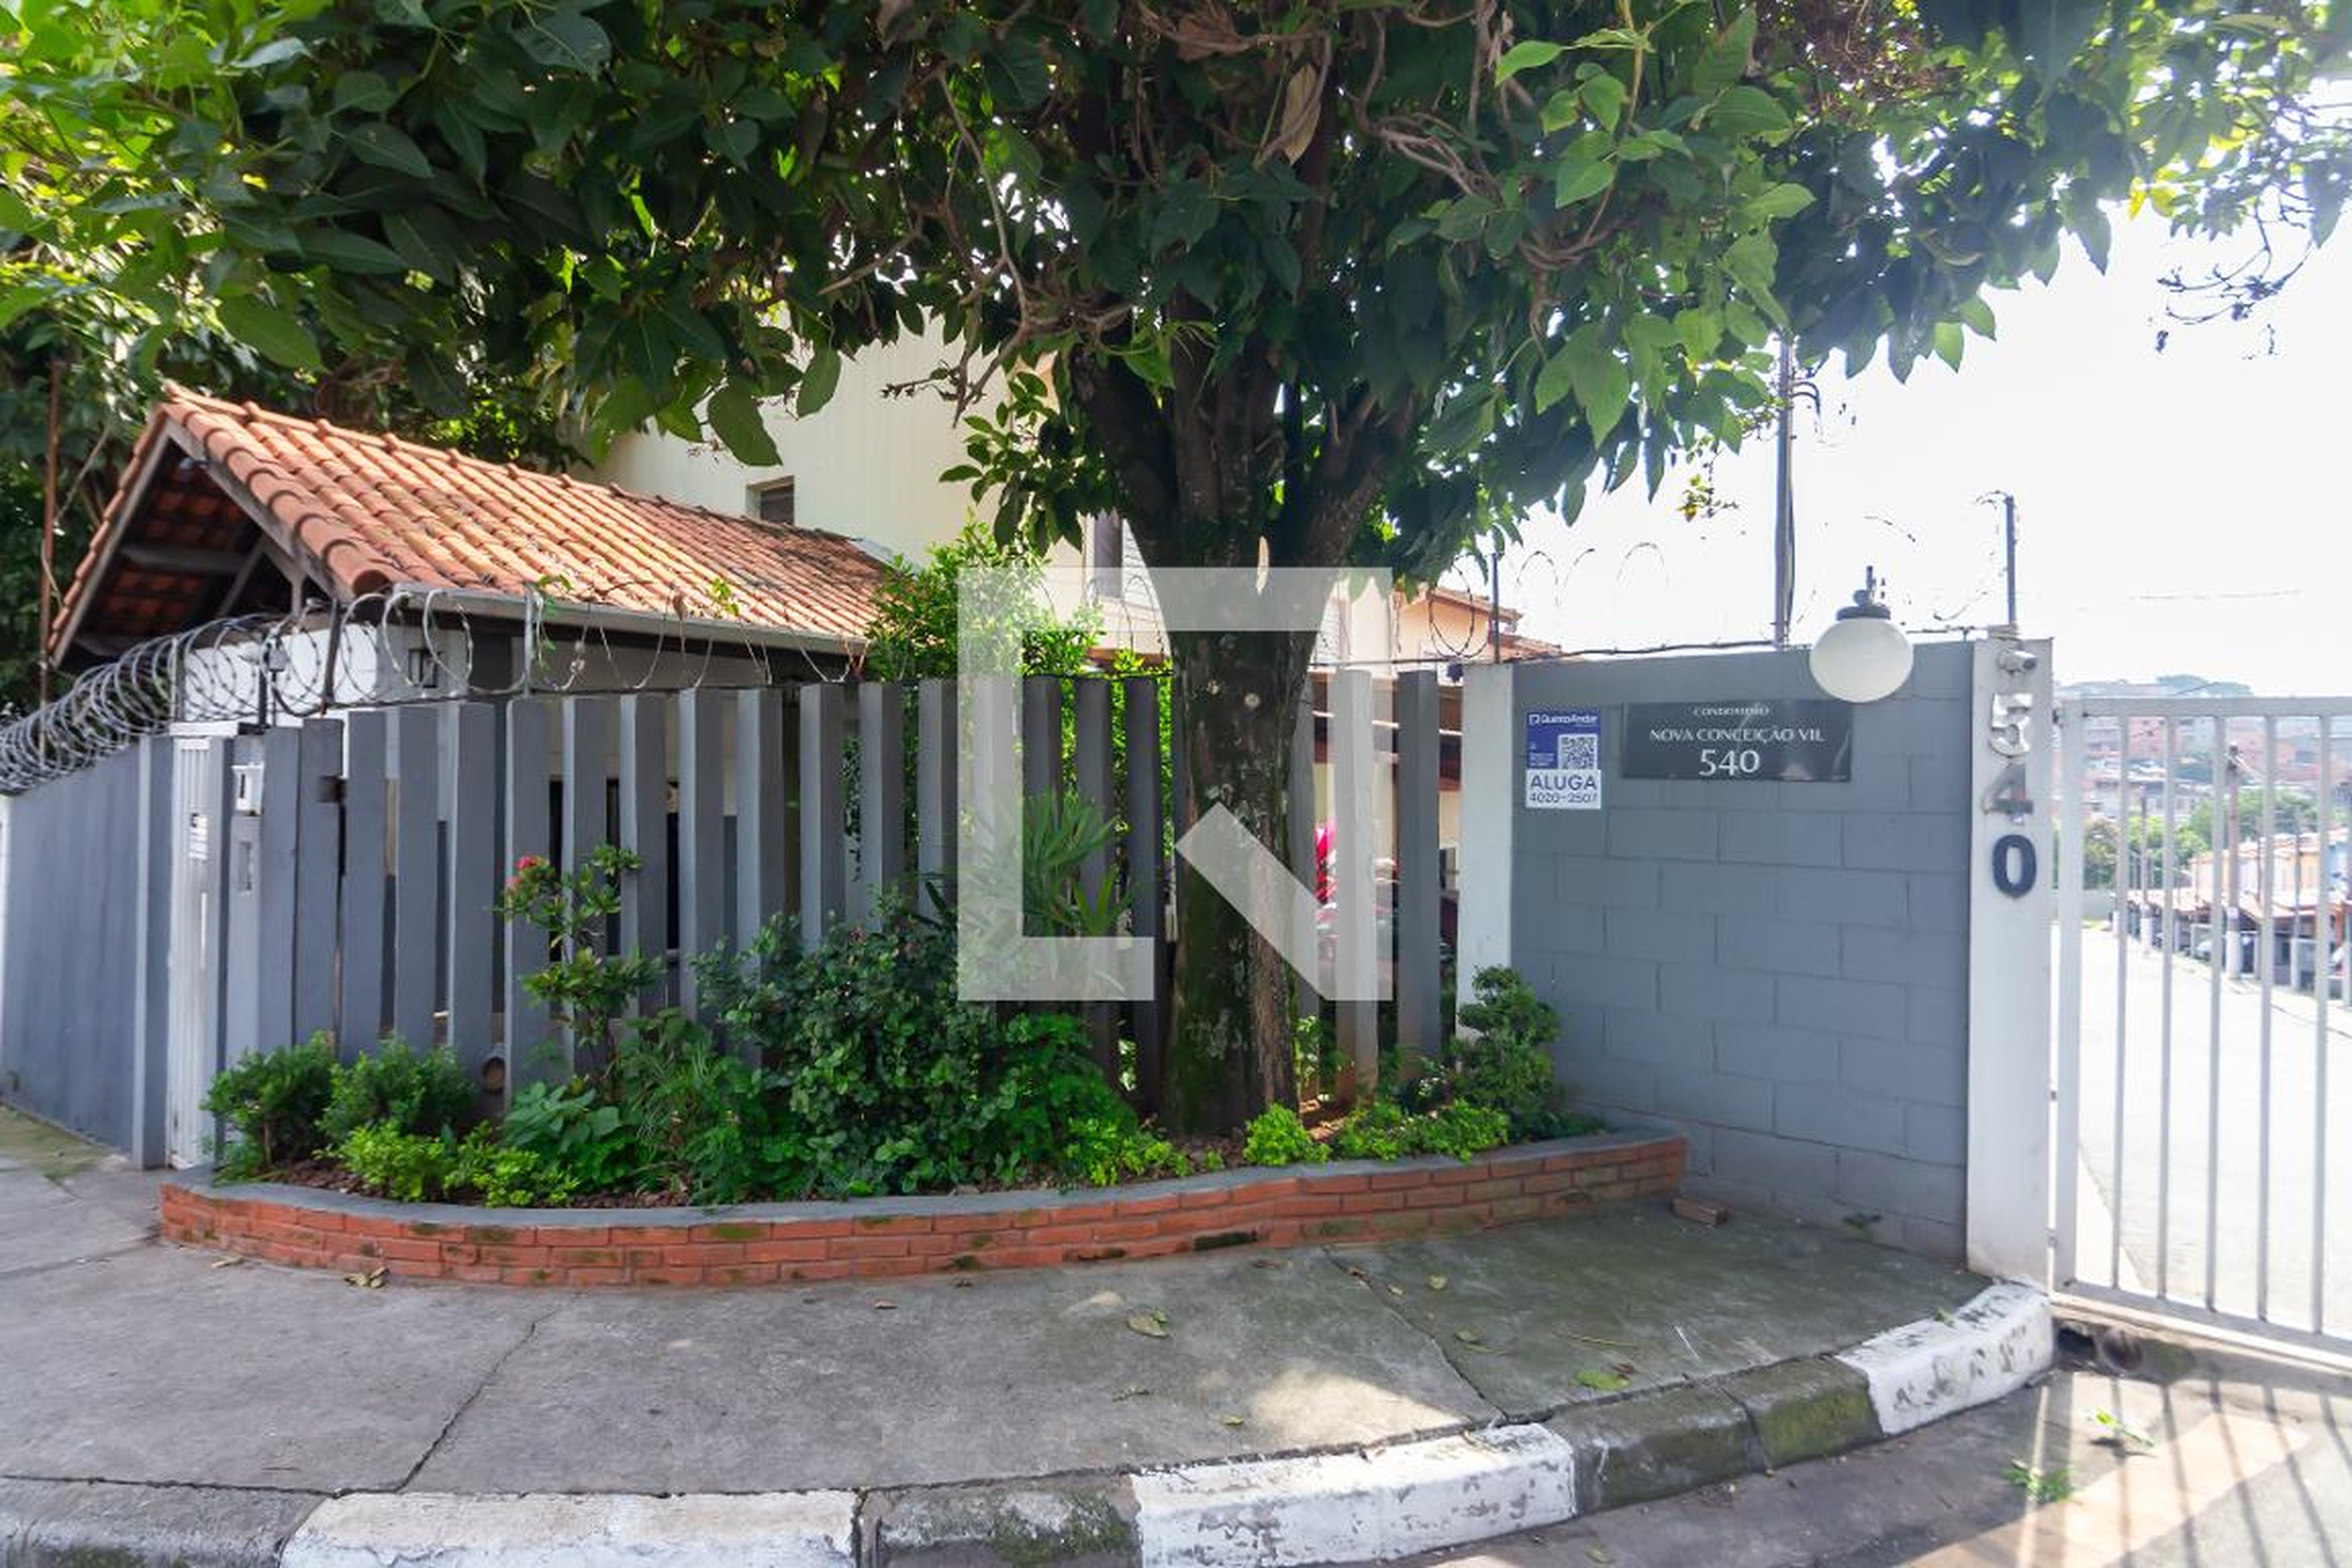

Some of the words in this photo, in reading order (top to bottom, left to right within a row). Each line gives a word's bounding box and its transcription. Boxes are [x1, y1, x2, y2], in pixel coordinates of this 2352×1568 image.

[1650, 728, 1694, 742] NOVA
[1696, 725, 1794, 744] CONCEIÇÃO
[1798, 728, 1827, 742] VIL
[1698, 748, 1760, 777] 540
[1531, 775, 1597, 790] ALUGA
